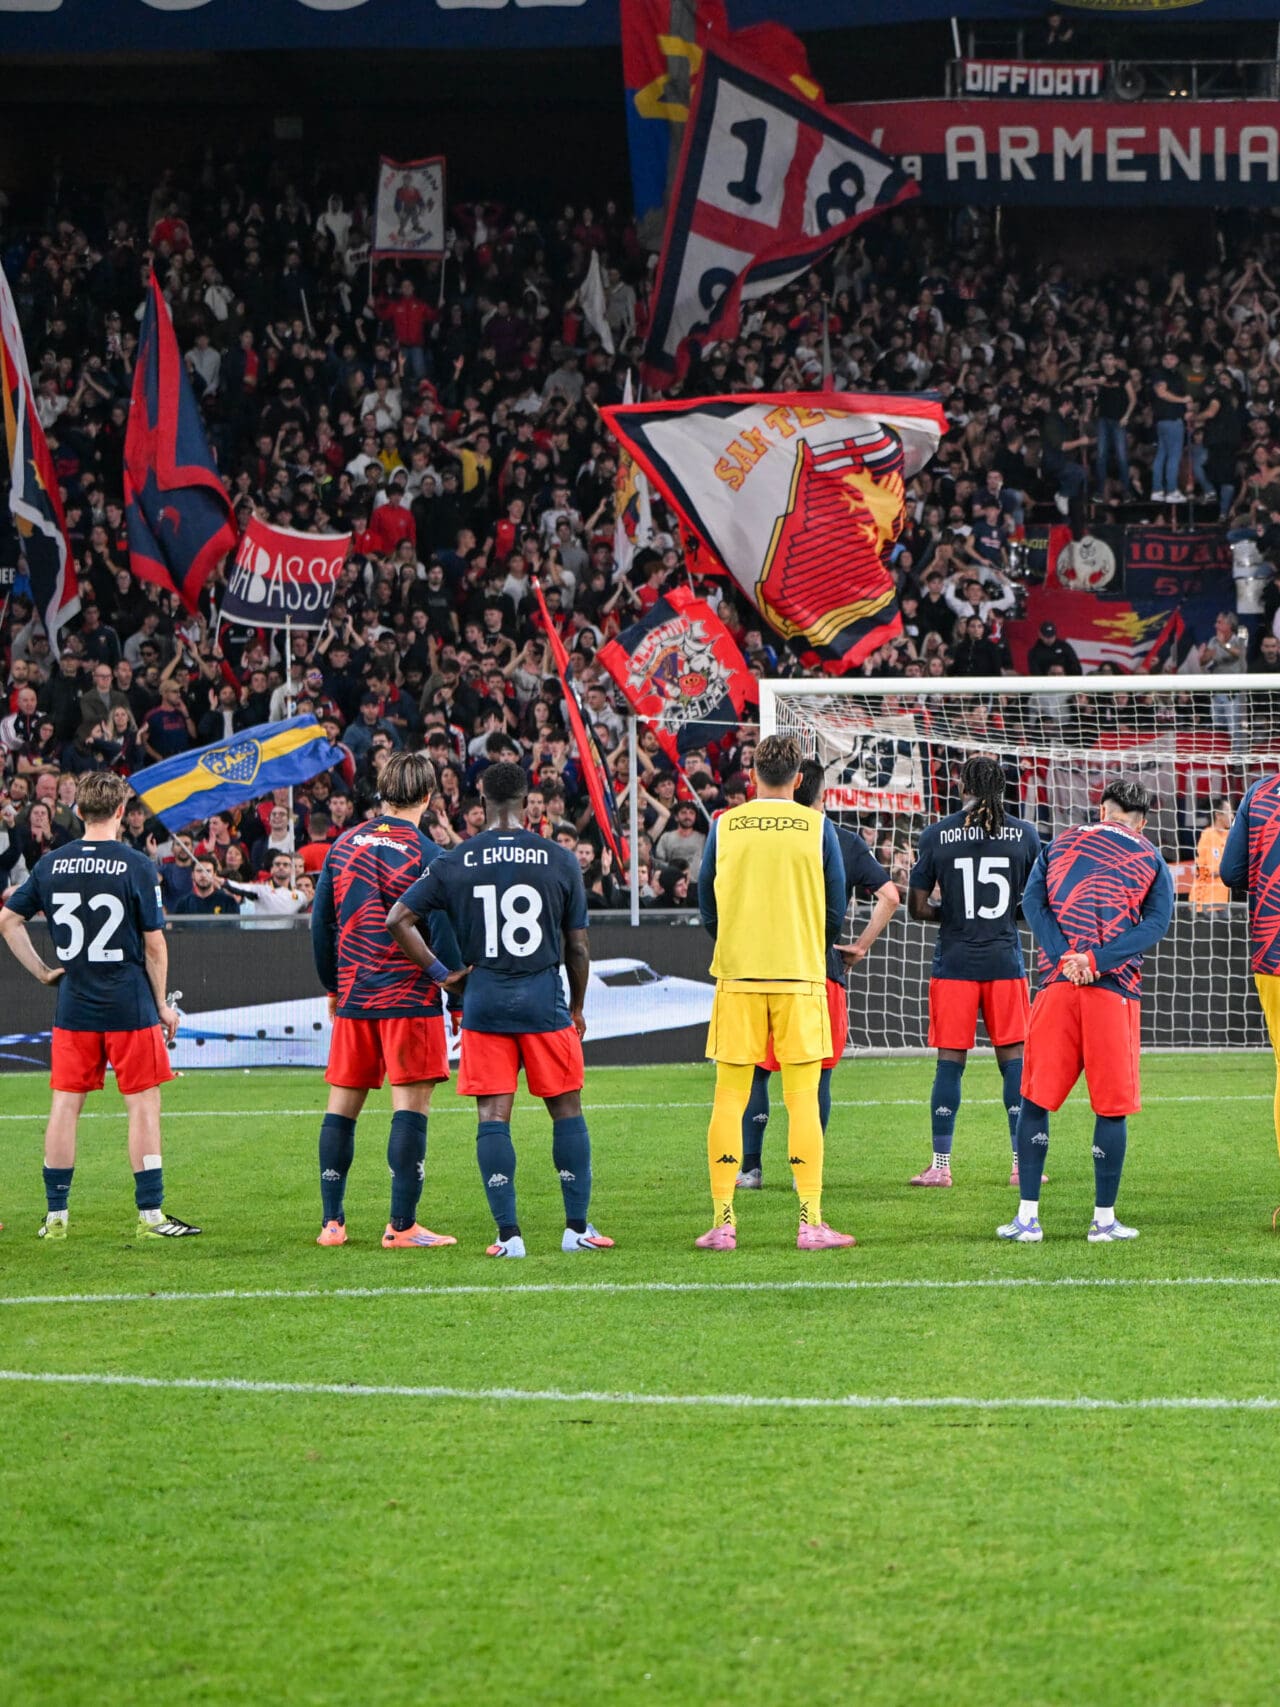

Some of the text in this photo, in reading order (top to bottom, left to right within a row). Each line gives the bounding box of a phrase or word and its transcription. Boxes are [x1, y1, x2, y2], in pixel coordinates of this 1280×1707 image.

[965, 61, 1100, 96] DIFFIDATI
[944, 125, 1280, 183] ARMENIA
[763, 405, 850, 439] TE
[729, 815, 809, 832] Kappa
[51, 856, 128, 876] FRENDRUP
[463, 846, 549, 867] C. EKUBAN
[953, 856, 1011, 920] 15
[51, 892, 125, 963] 32
[472, 883, 543, 958] 18
